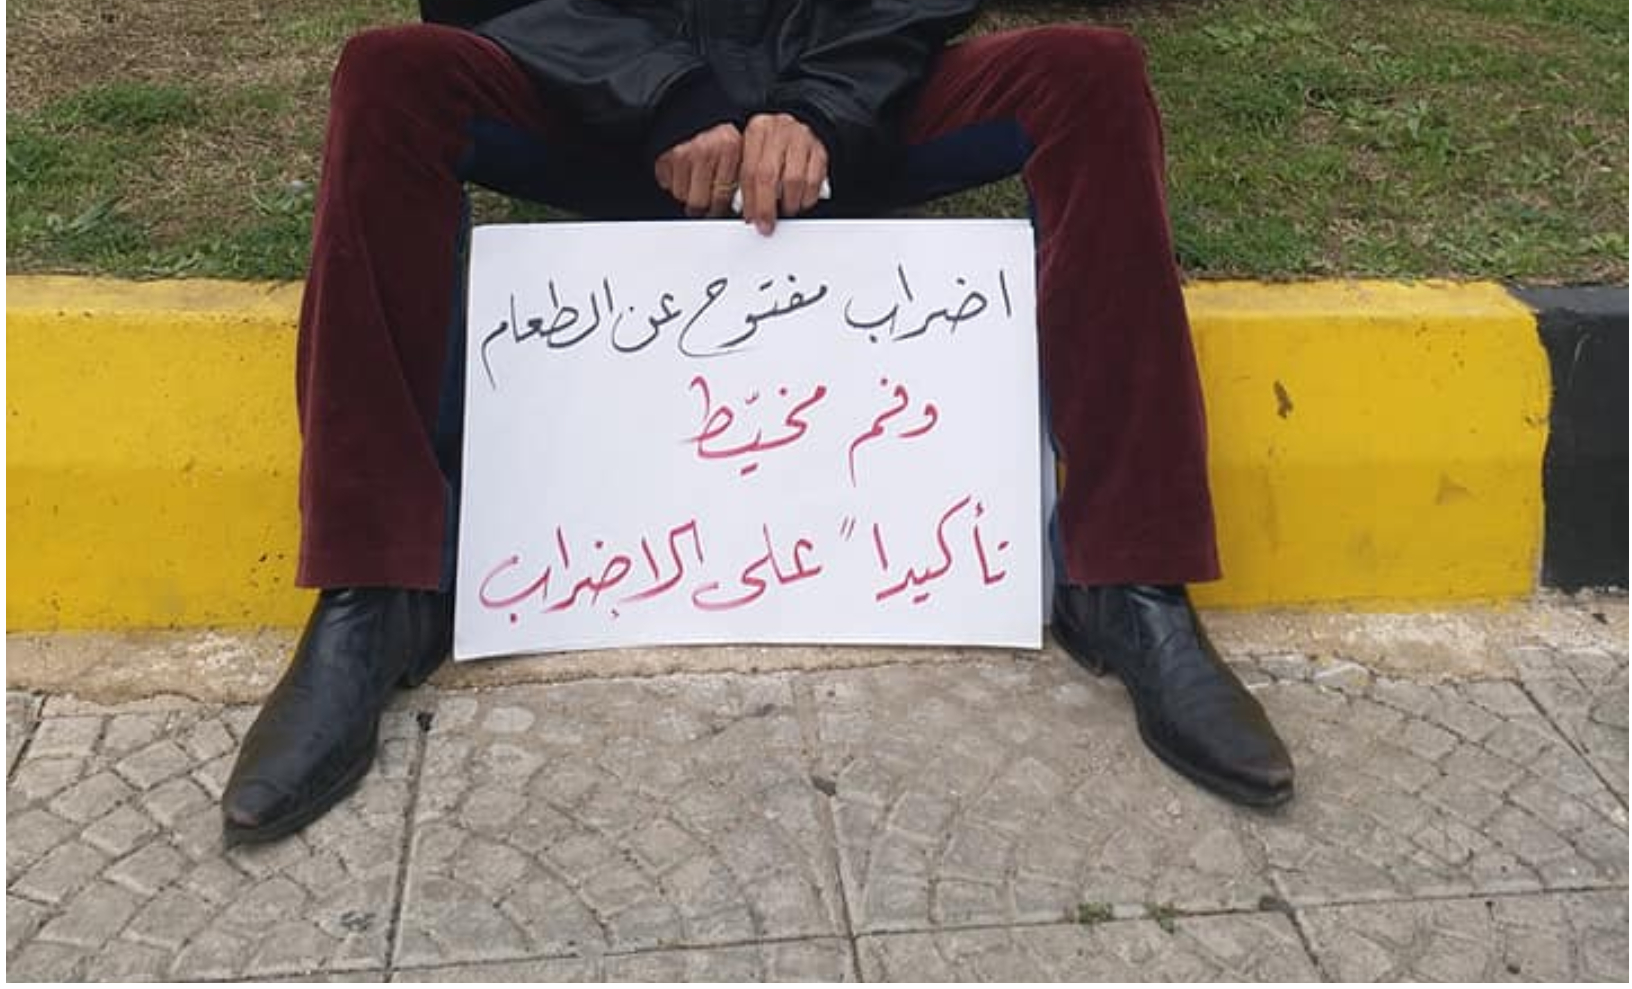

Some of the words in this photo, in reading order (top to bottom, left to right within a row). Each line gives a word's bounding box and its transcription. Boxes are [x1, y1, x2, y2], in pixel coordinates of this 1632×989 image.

[480, 277, 614, 392] الطعام
[611, 291, 683, 354] عن
[677, 274, 829, 359] مفتوح
[842, 262, 1013, 344] اضراب
[847, 376, 939, 487] وفم
[690, 522, 824, 612] على
